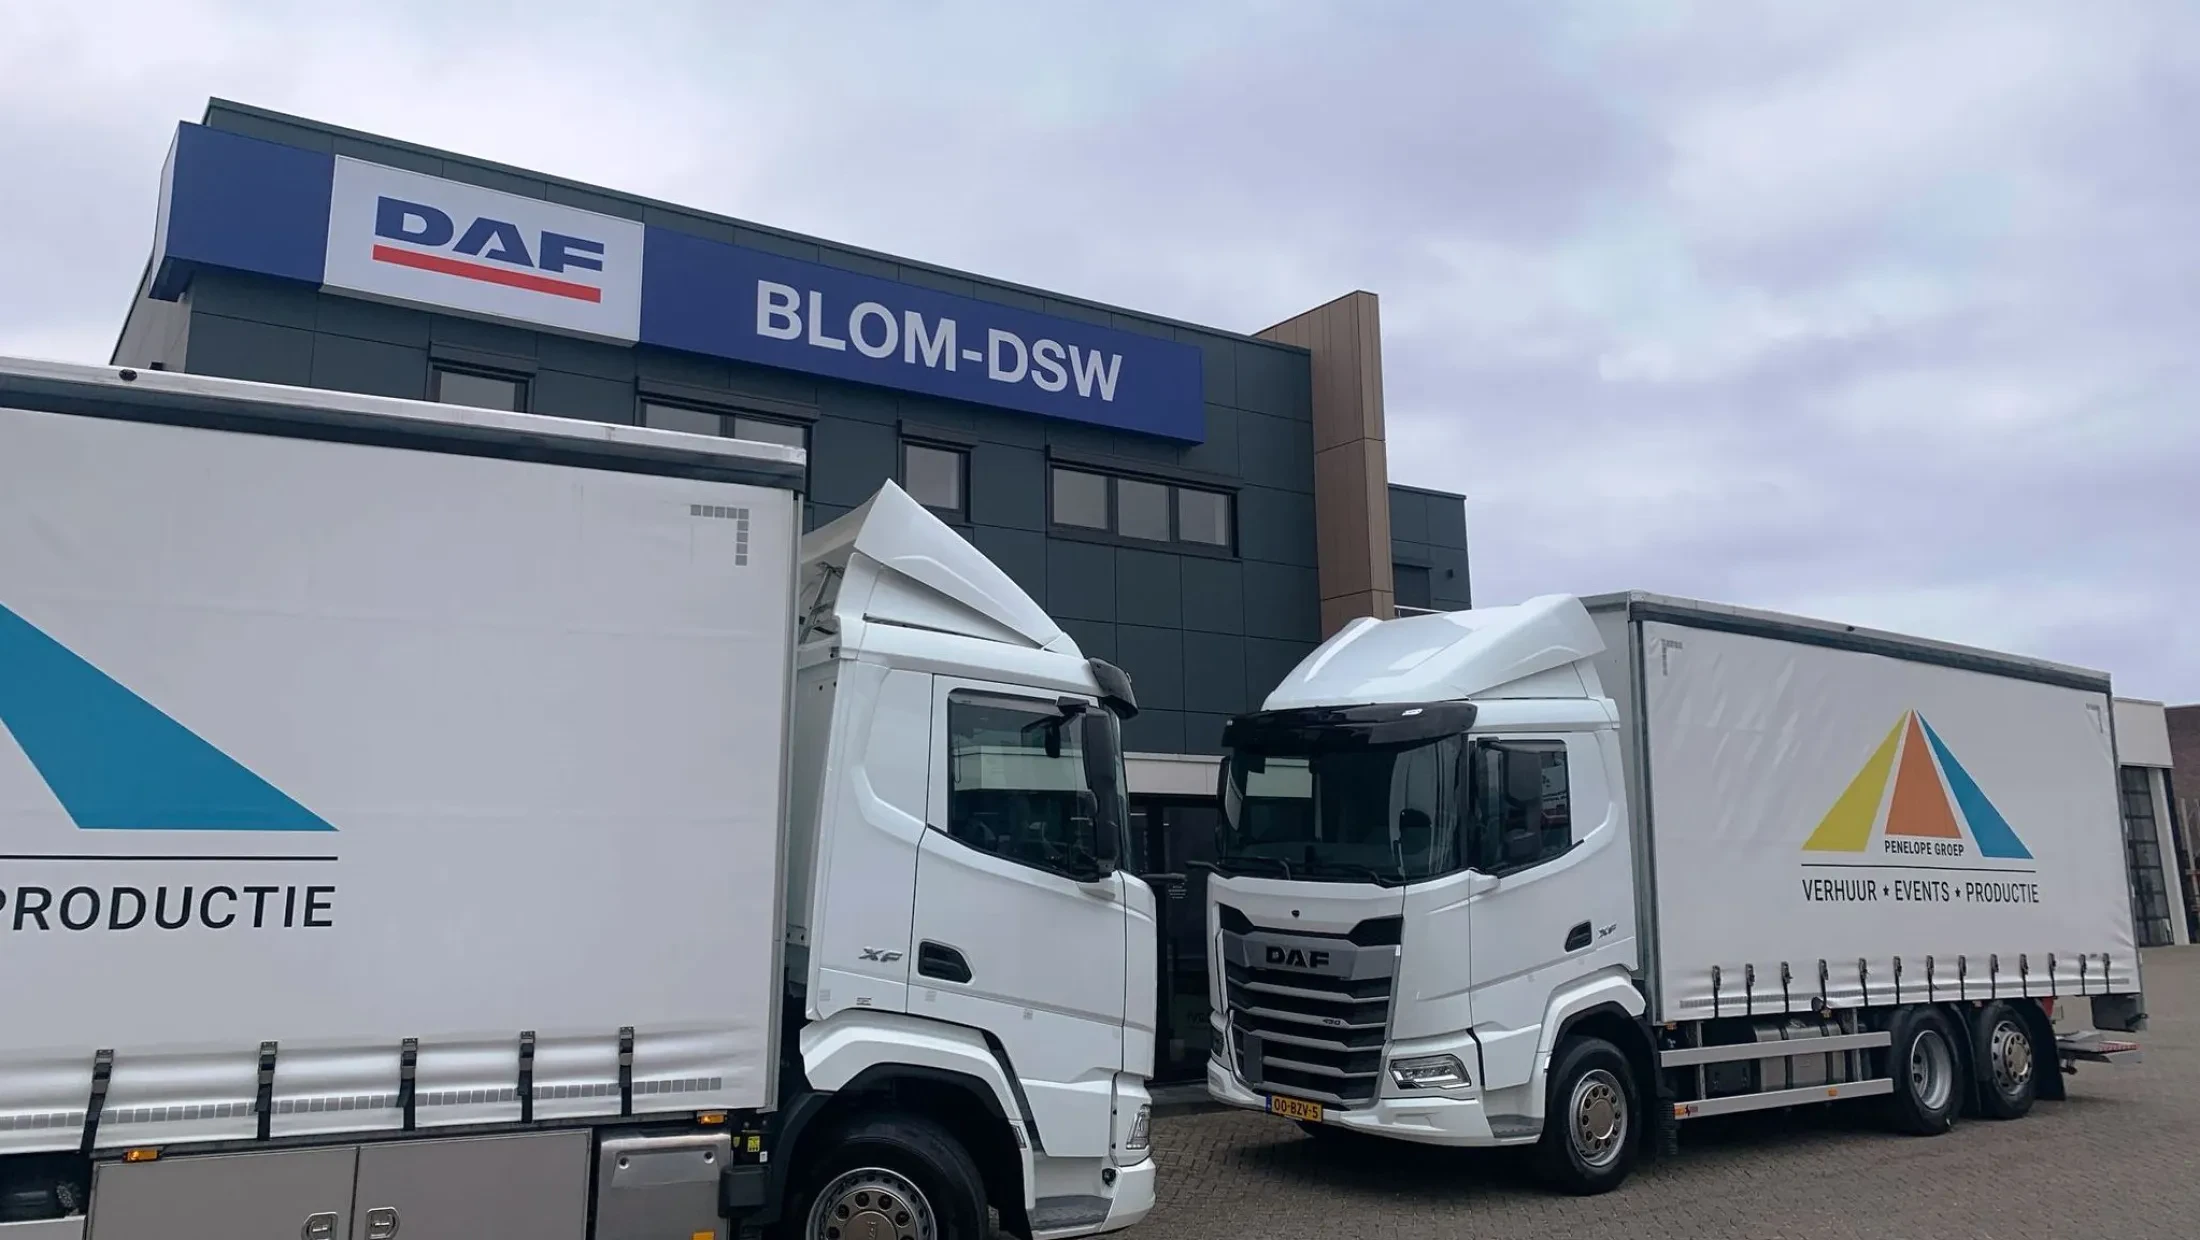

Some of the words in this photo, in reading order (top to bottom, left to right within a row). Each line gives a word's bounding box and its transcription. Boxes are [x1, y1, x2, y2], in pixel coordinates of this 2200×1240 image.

[375, 195, 604, 274] DAF
[756, 279, 1123, 402] BLOM-DSW
[1884, 840, 1932, 855] PENELOPE
[1934, 842, 1964, 857] GROEP
[1802, 879, 1877, 901] VERHUUR
[1895, 880, 1950, 902] EVENTS
[1966, 882, 2040, 904] PRODUCTIE
[858, 947, 903, 962] XF
[1266, 946, 1330, 968] DAF
[1274, 1098, 1319, 1119] 00-BZV-5
